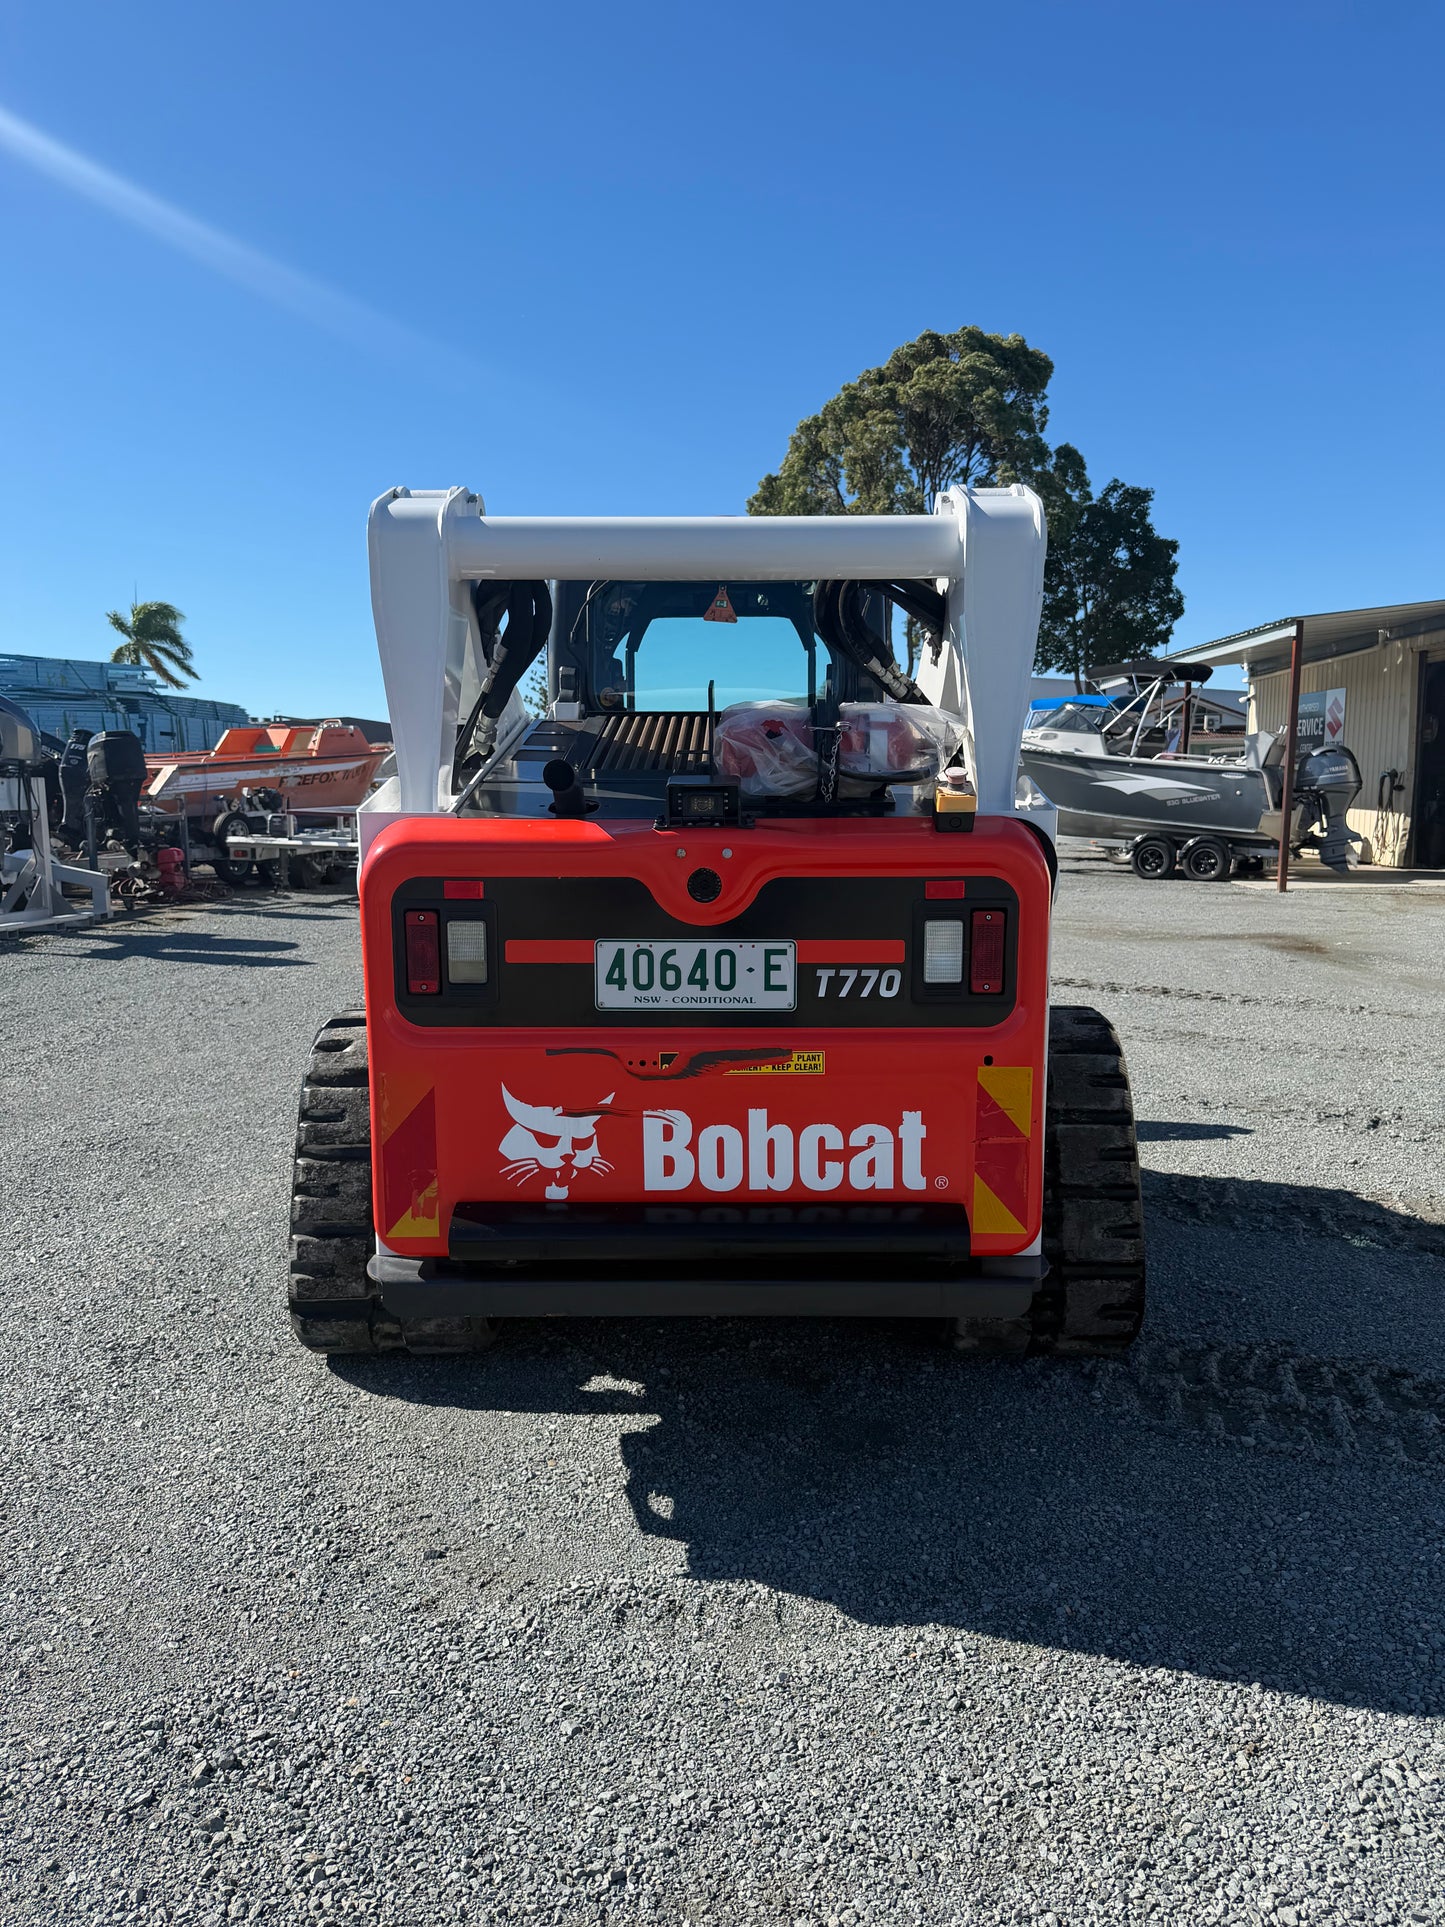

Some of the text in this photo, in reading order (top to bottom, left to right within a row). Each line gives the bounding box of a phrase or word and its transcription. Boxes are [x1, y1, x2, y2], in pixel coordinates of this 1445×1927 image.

[1297, 717, 1324, 736] ERVICE
[816, 969, 902, 998] T770
[634, 996, 662, 1004] NSW
[671, 996, 757, 1004] CONDITIONAL
[797, 1054, 821, 1062] PLANT
[771, 1063, 792, 1071] KEEP
[794, 1063, 821, 1071] CLEAR!
[642, 1108, 927, 1192] Bobcat
